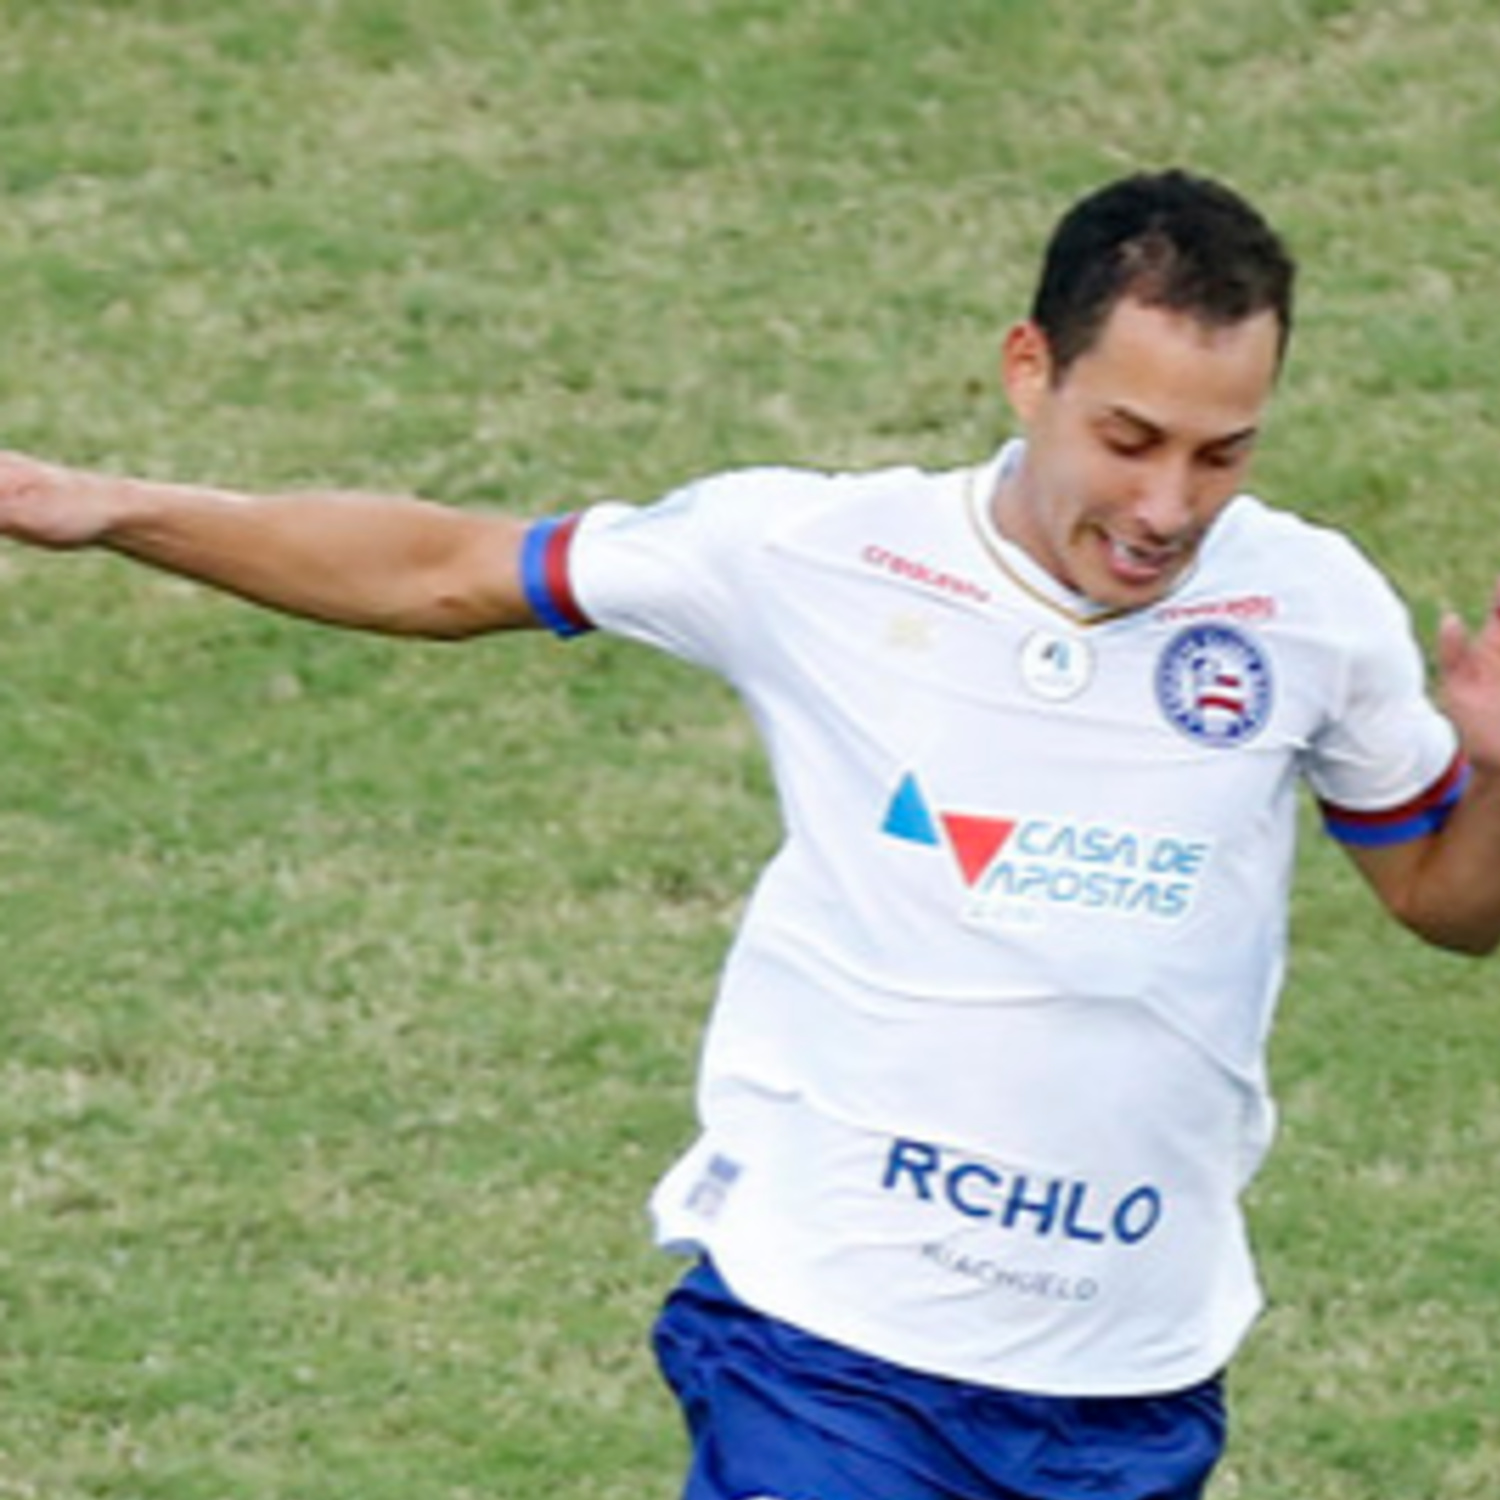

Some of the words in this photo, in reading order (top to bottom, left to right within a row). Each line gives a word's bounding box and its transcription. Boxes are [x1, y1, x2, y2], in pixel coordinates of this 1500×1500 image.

[1015, 820, 1138, 867] CASA
[1147, 838, 1208, 875] DE
[982, 860, 1192, 917] APOSTAS
[880, 1136, 1163, 1245] RCHLO
